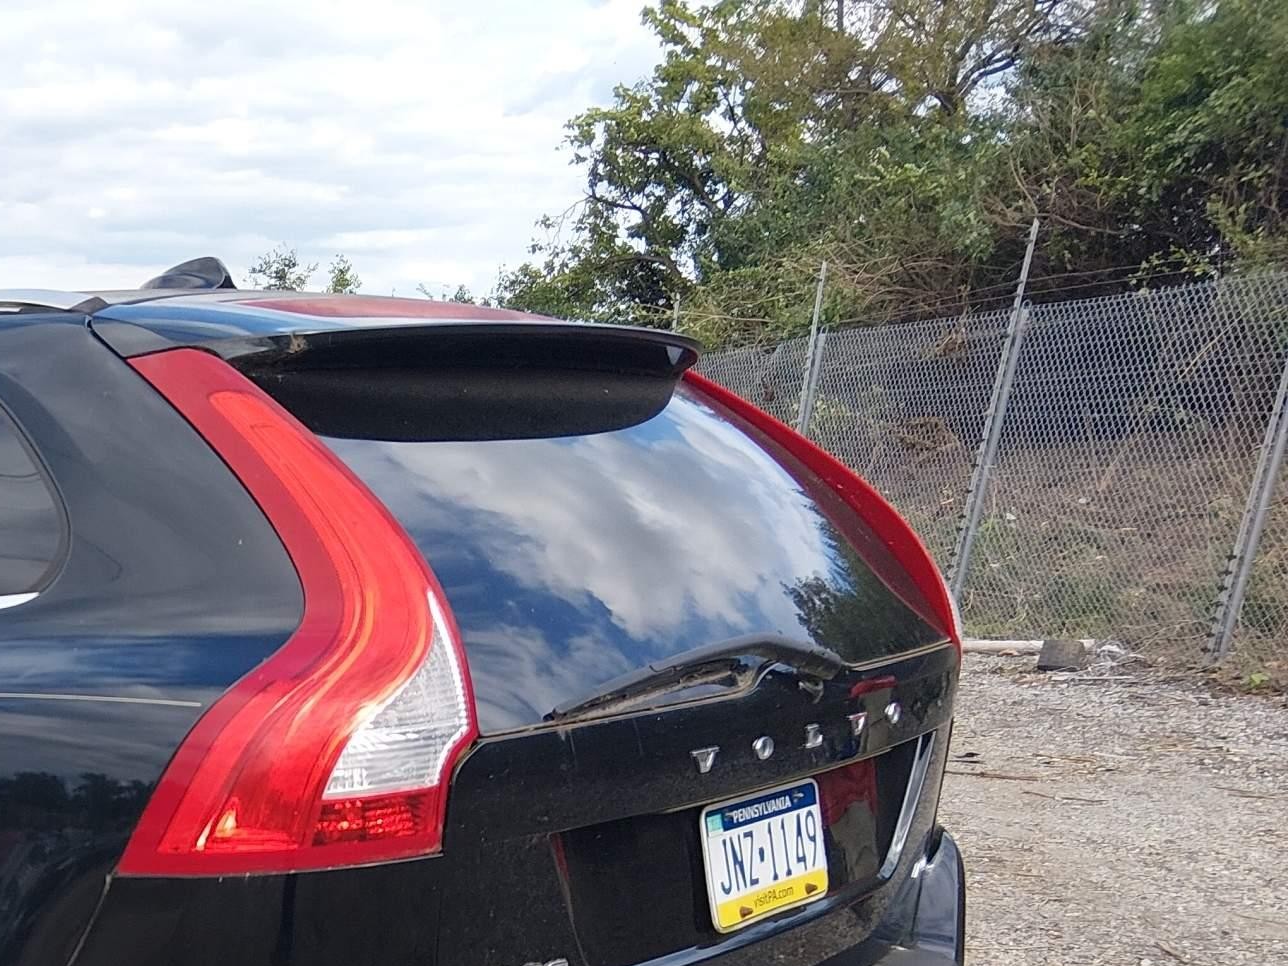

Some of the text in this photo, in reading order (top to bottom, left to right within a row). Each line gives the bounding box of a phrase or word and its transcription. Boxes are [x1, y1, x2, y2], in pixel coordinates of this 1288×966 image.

[690, 702, 902, 774] VOLVO
[732, 795, 792, 824] PENNSYLVANIA
[753, 886, 795, 909] visitPA.com
